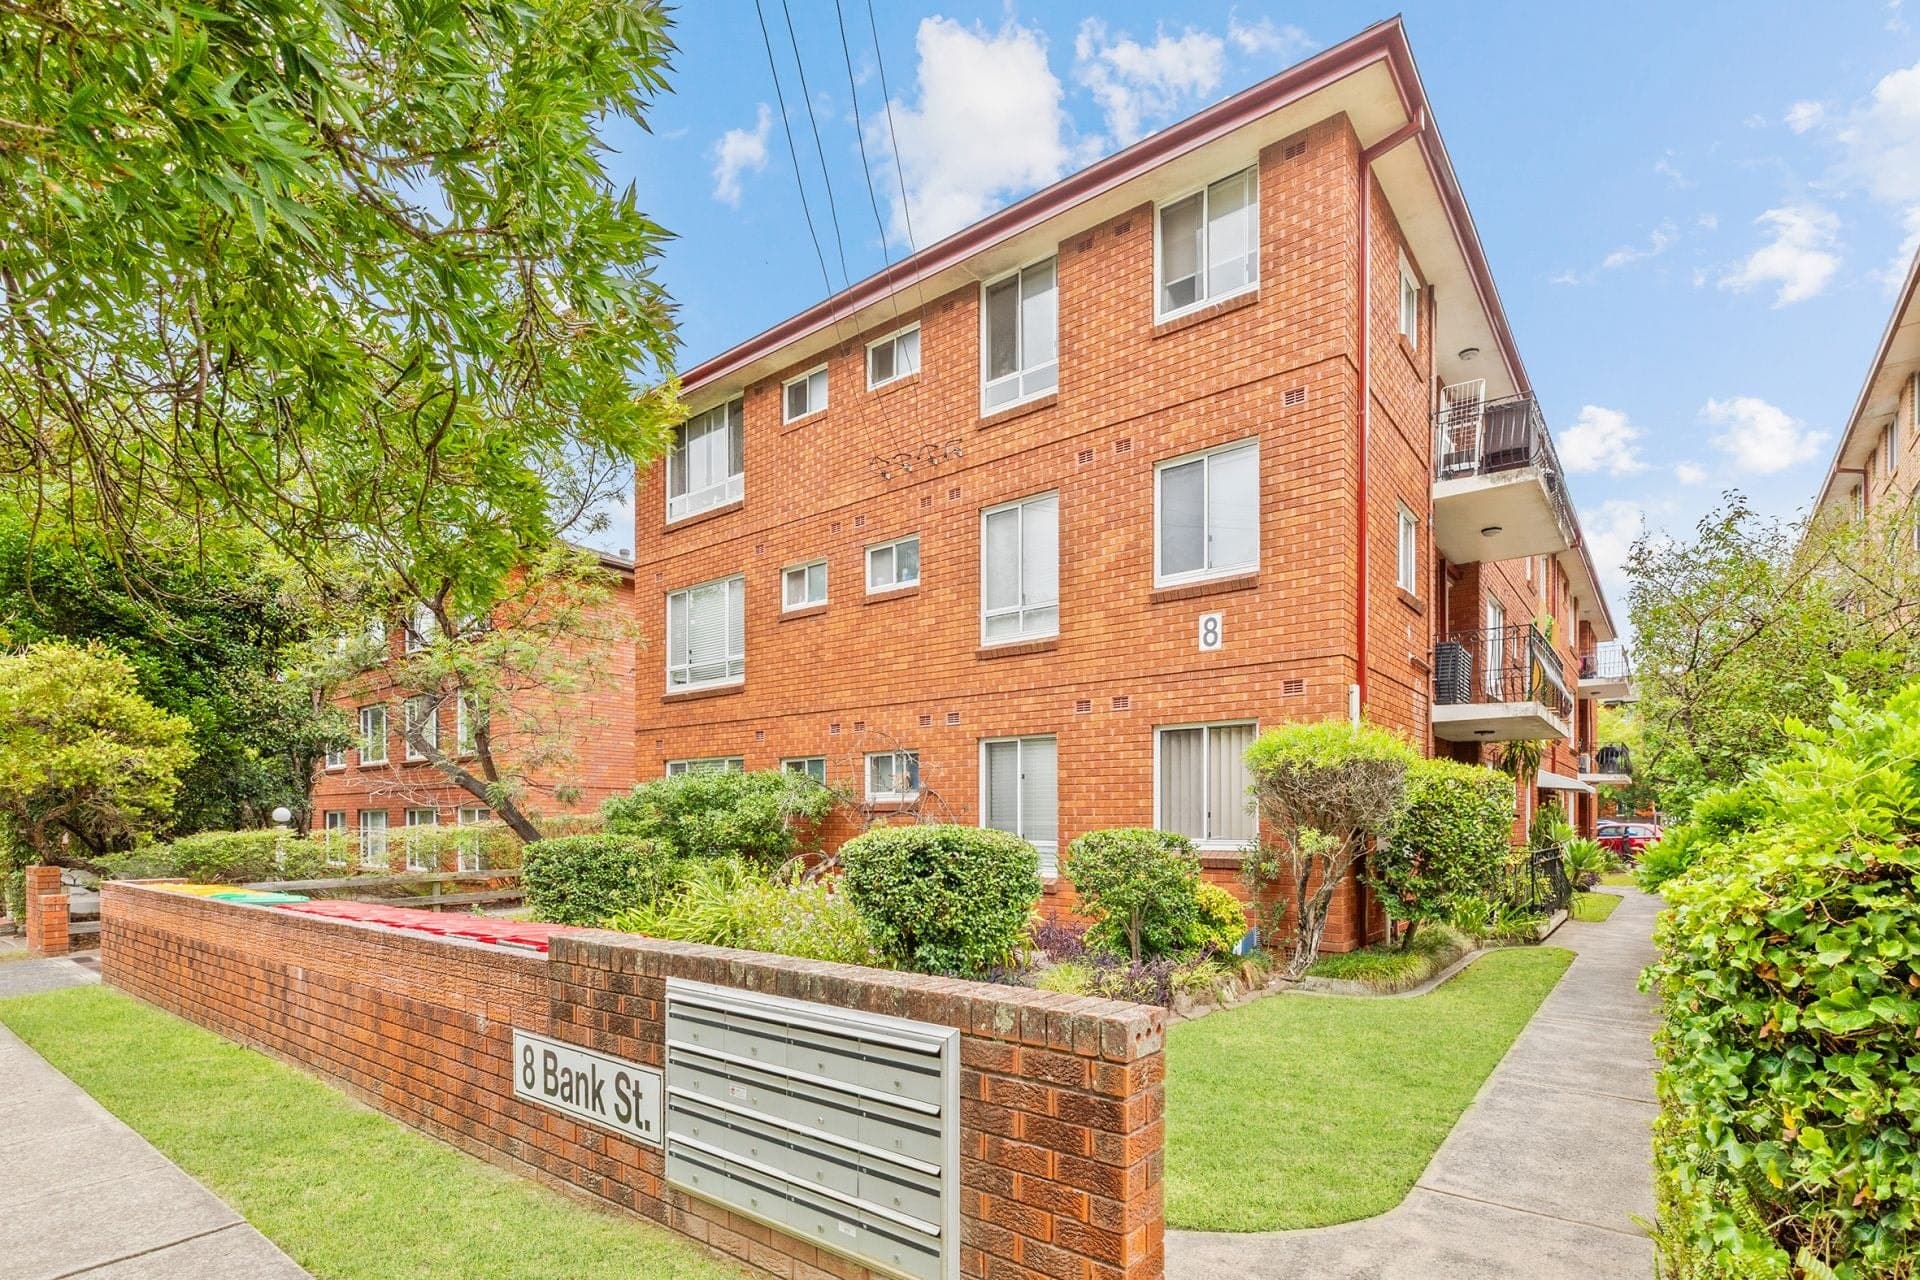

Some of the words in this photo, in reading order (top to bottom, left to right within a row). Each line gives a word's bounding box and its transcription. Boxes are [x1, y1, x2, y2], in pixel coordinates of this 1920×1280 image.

[1203, 617, 1218, 647] 8
[522, 1044, 535, 1090] 8
[543, 1049, 606, 1115] Bank
[614, 1071, 650, 1132] St.
